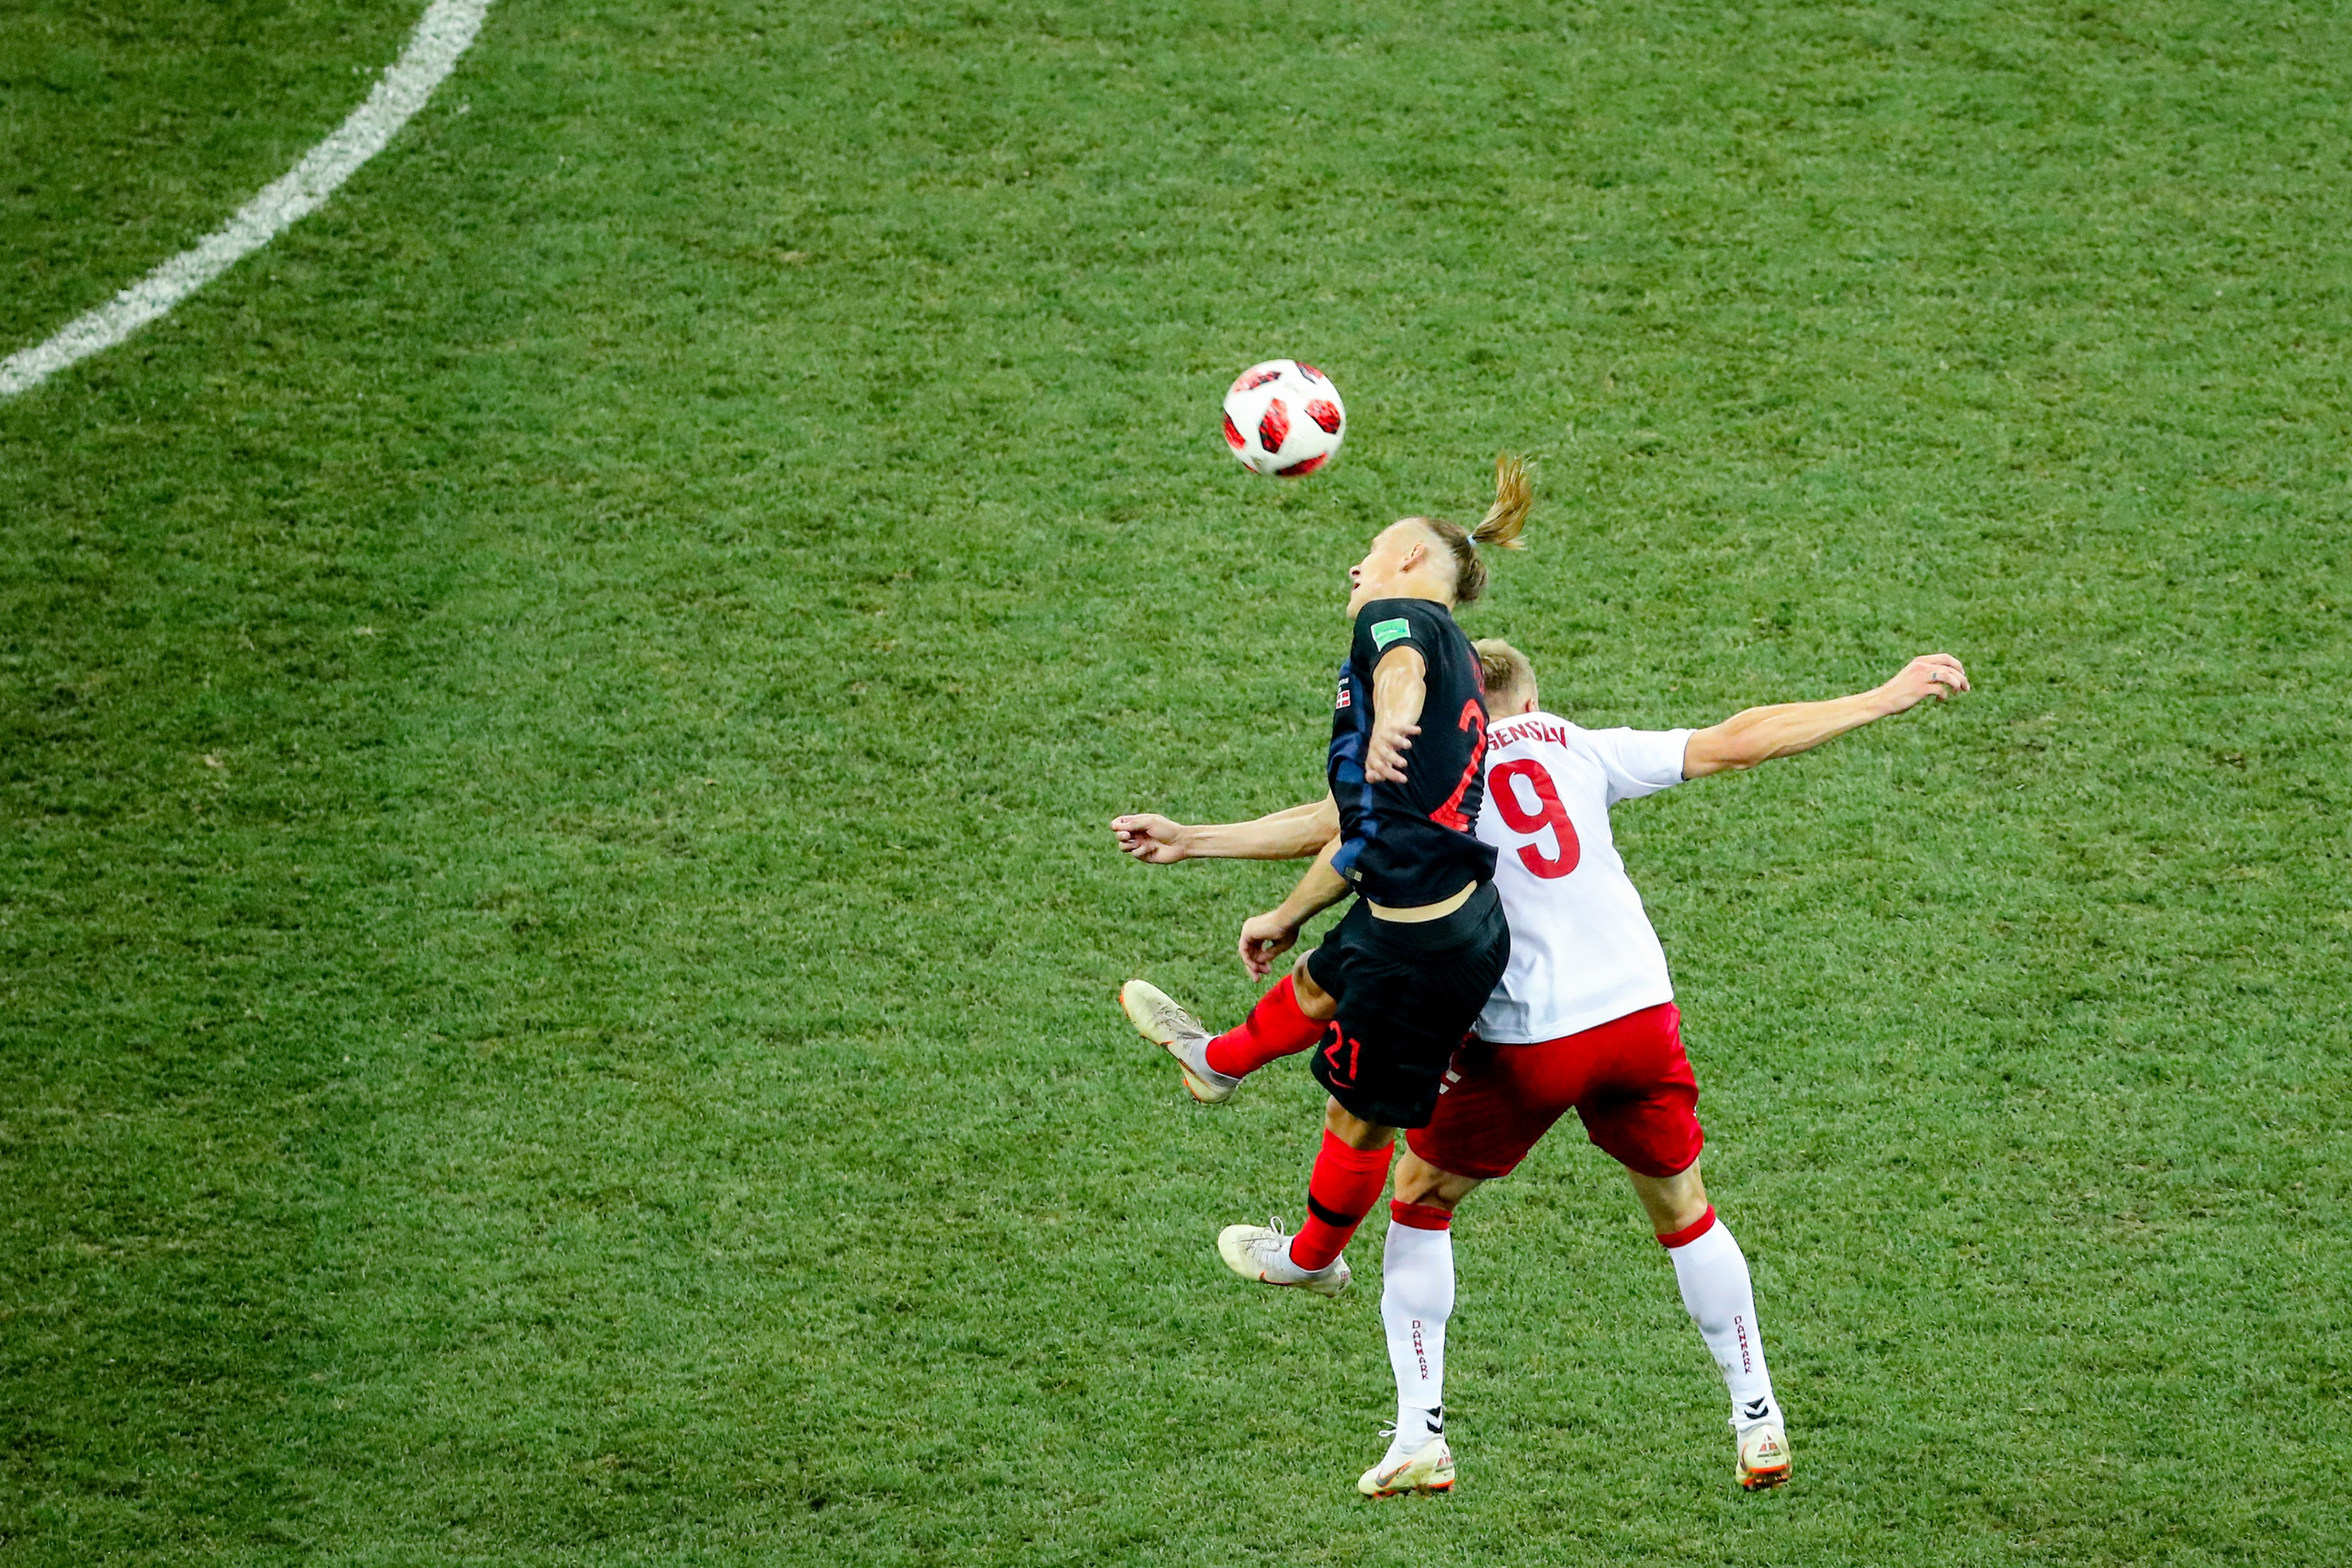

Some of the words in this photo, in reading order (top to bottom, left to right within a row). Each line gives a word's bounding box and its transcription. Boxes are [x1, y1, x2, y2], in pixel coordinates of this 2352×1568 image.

[1487, 758, 1580, 879] 9
[1323, 1021, 1361, 1080] 21
[1412, 1320, 1429, 1380] DANMARK
[1734, 1315, 1752, 1374] DANMARK
